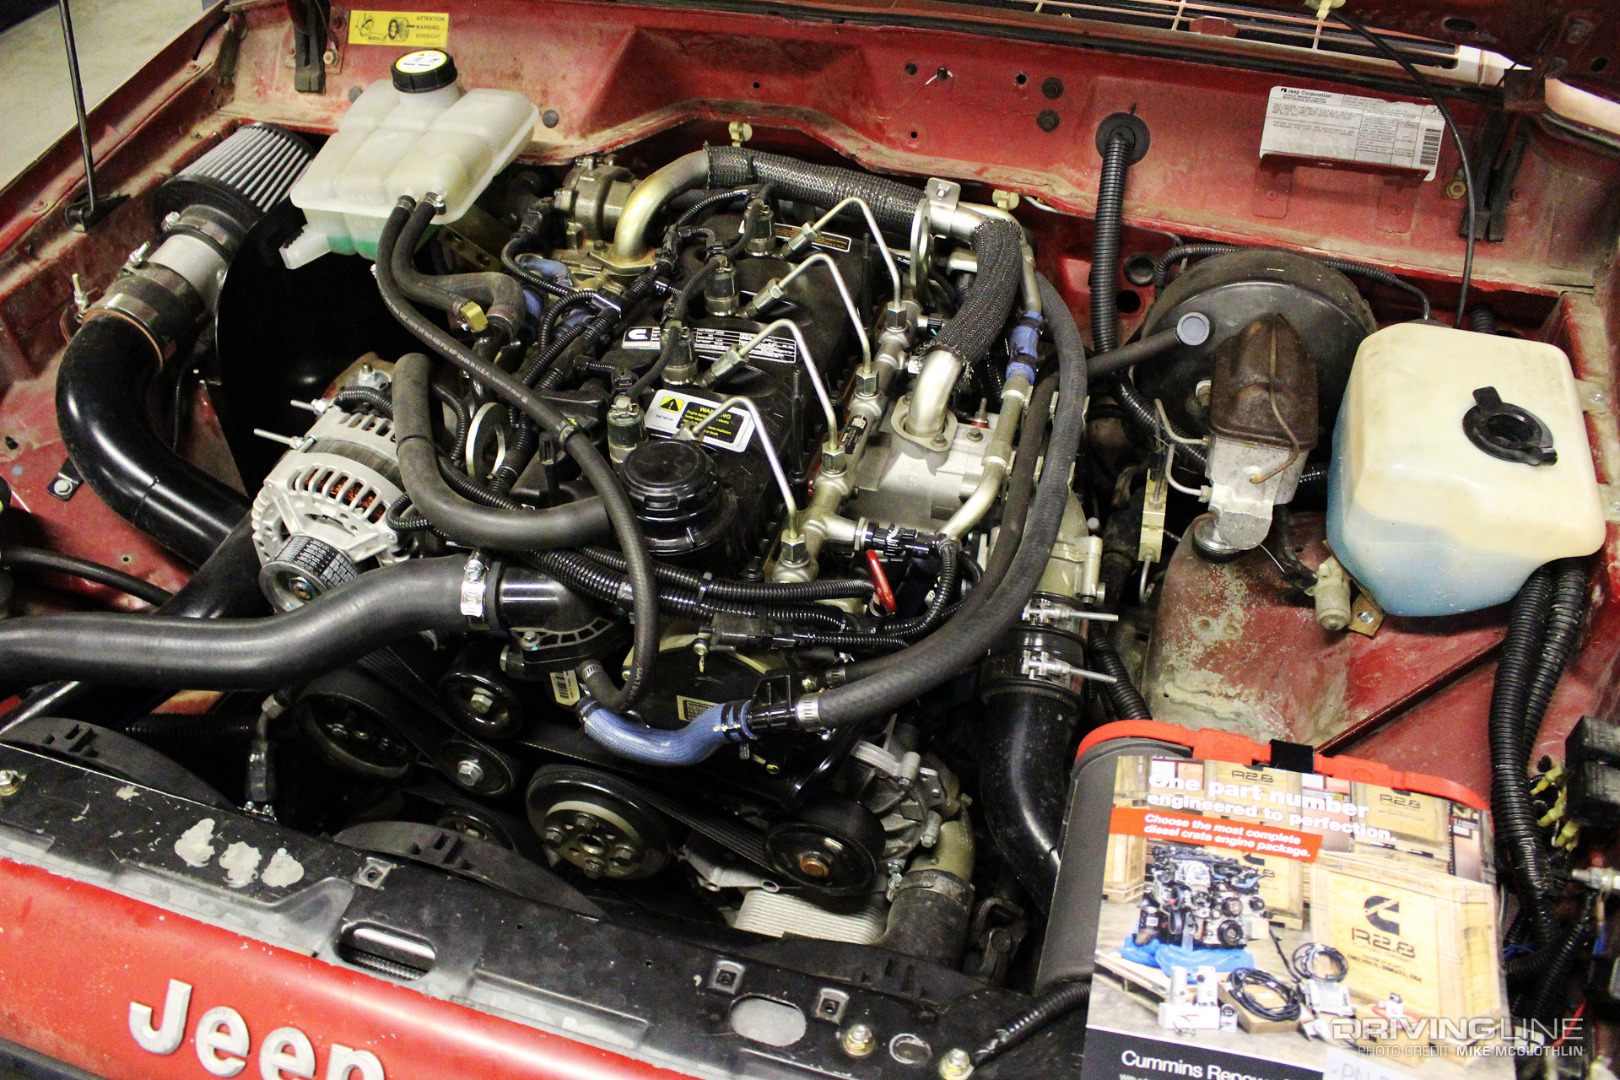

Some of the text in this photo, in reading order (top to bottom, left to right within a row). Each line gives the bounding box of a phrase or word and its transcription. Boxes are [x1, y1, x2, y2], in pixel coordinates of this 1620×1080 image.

[1231, 769, 1274, 783] R2.8
[1148, 772, 1370, 818] One part number
[1144, 813, 1302, 845] Choose the most complete
[1147, 794, 1397, 842] engineered to perfection.
[1143, 824, 1311, 858] diesel crate engine package.
[1351, 927, 1416, 959] R2.8
[1120, 1049, 1204, 1079] Cummins
